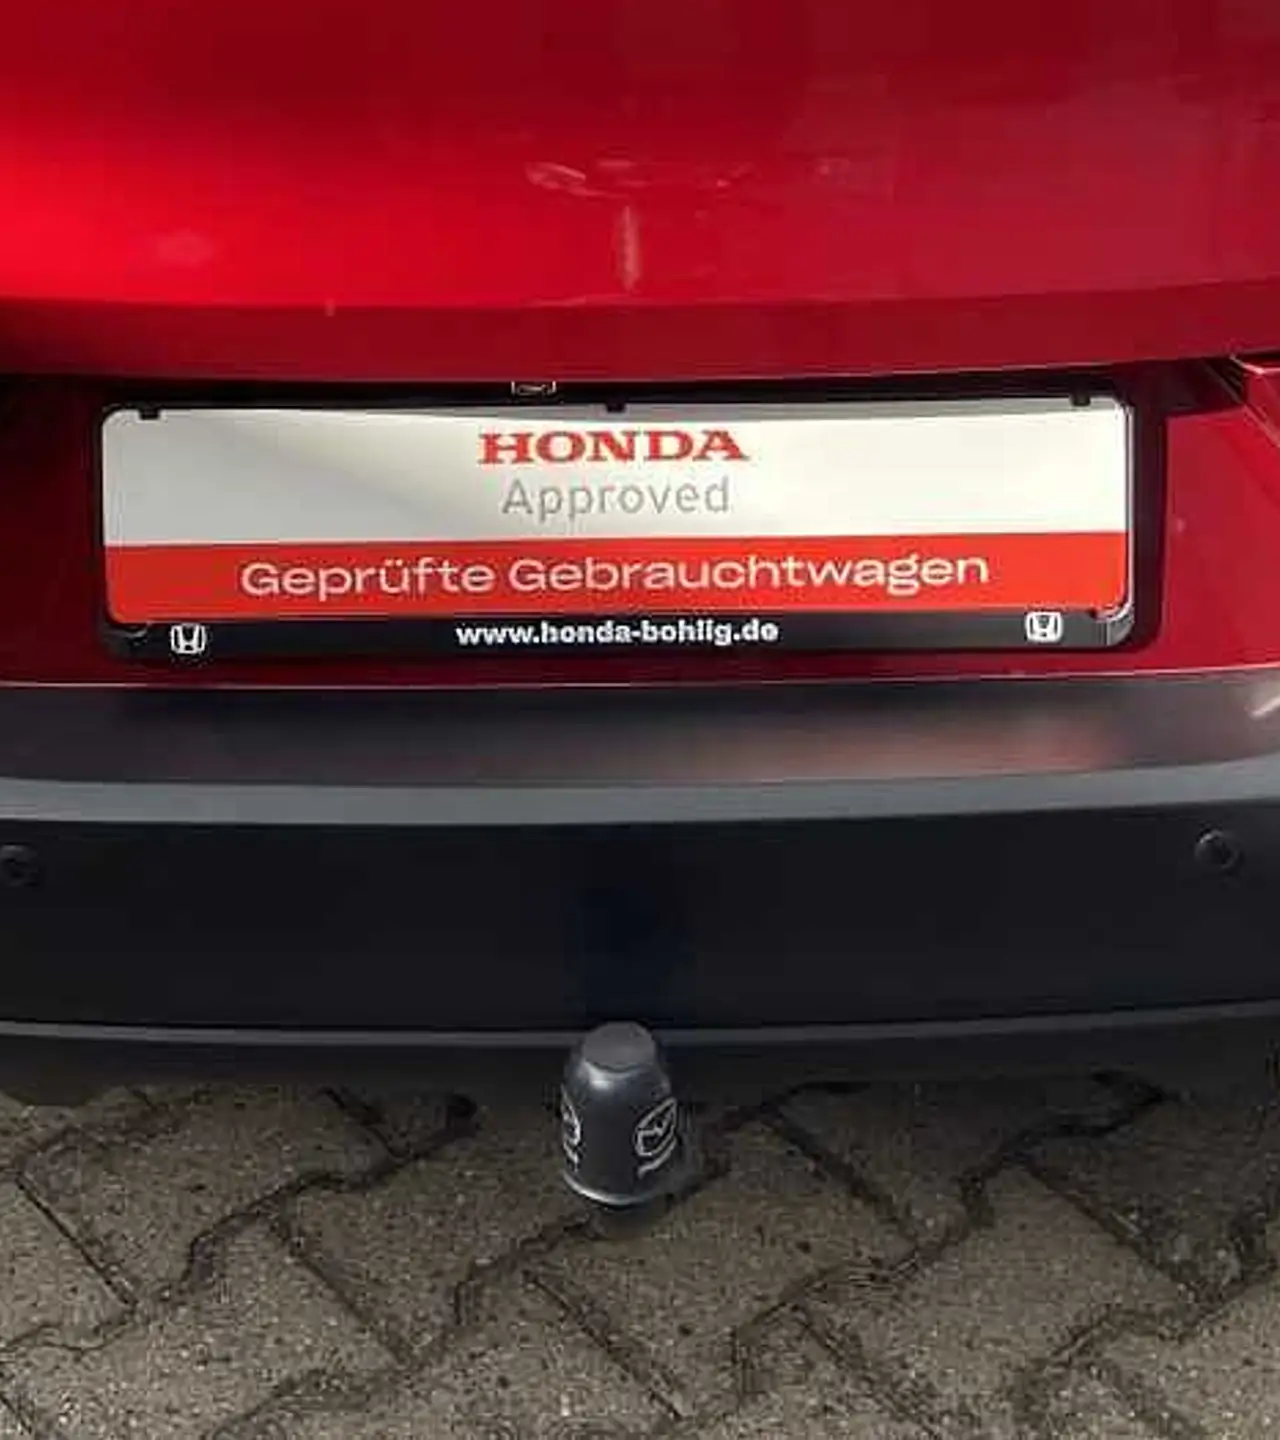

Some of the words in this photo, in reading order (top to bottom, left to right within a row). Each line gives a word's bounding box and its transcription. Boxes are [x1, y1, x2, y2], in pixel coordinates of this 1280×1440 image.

[477, 428, 751, 466] HONDA
[500, 475, 731, 522] Approved
[240, 556, 496, 602] Geprüfte
[507, 552, 989, 597] Gebrauchtwagen
[455, 617, 780, 647] www.honda-bohlig.de
